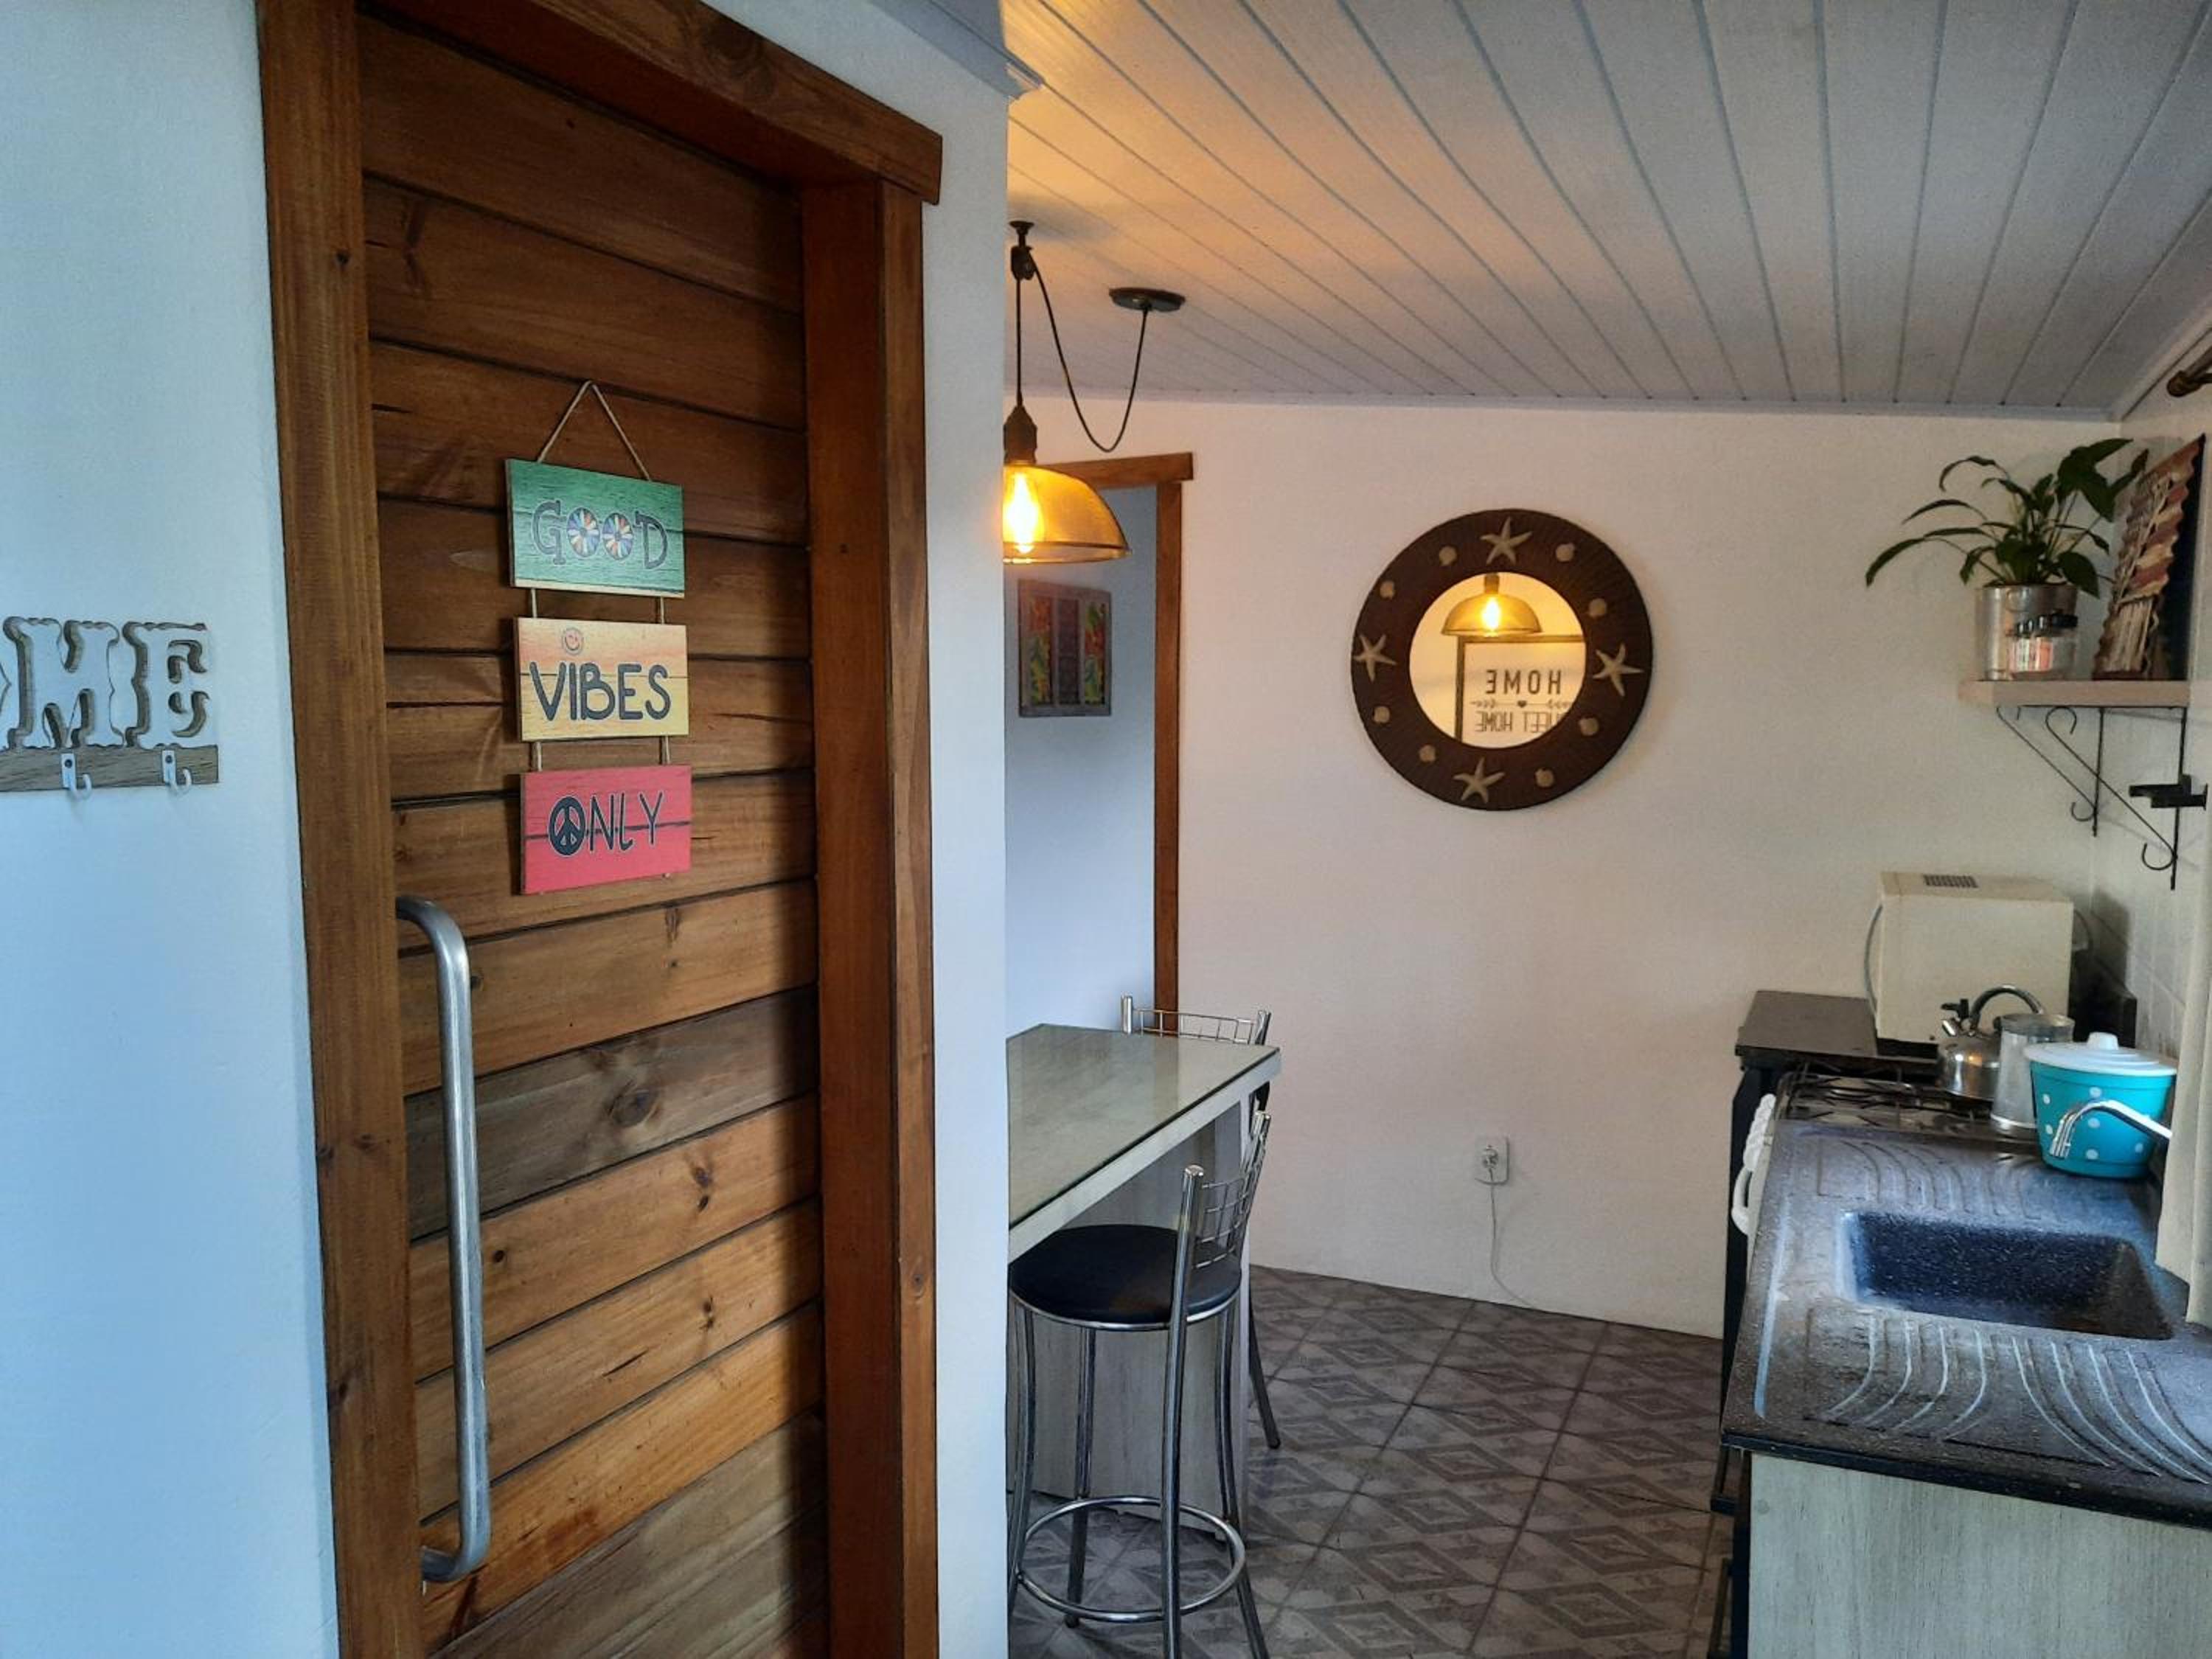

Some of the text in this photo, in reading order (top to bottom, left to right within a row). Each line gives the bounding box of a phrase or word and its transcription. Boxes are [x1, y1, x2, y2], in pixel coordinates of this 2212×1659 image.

[532, 500, 668, 569] GOOD
[0, 616, 211, 748] ME
[529, 661, 672, 721] VIBES
[548, 790, 665, 858] ONLY
